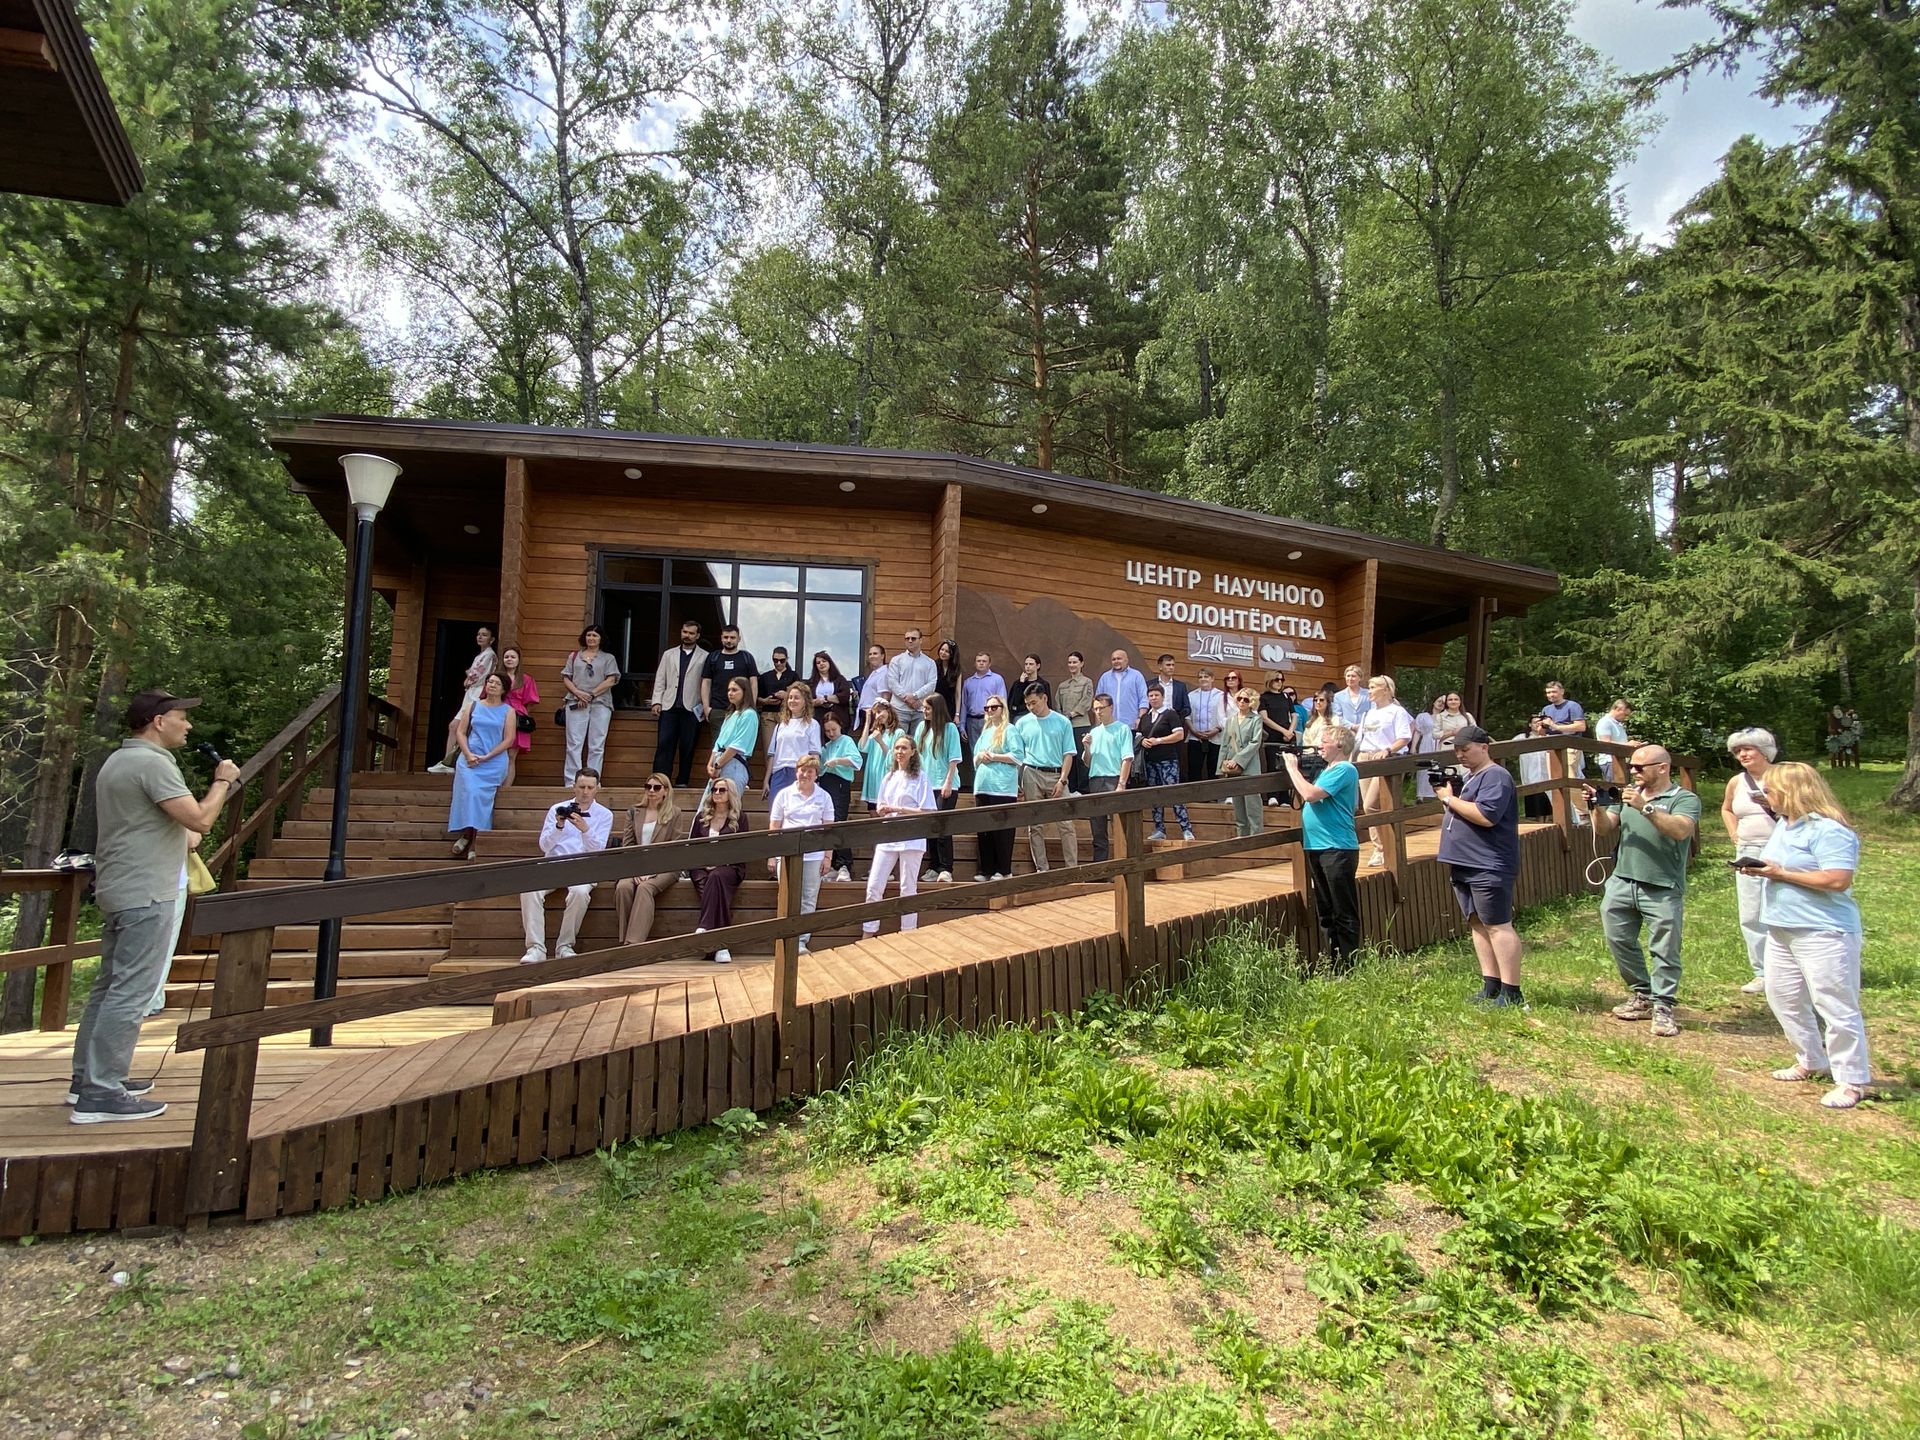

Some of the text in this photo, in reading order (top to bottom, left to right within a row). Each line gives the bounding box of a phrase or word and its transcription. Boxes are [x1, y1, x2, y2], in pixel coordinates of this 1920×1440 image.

[1126, 560, 1325, 608] ЦЕНТР НАУЧНОГО
[1157, 599, 1326, 640] ВОЛОНТЁРСТВА
